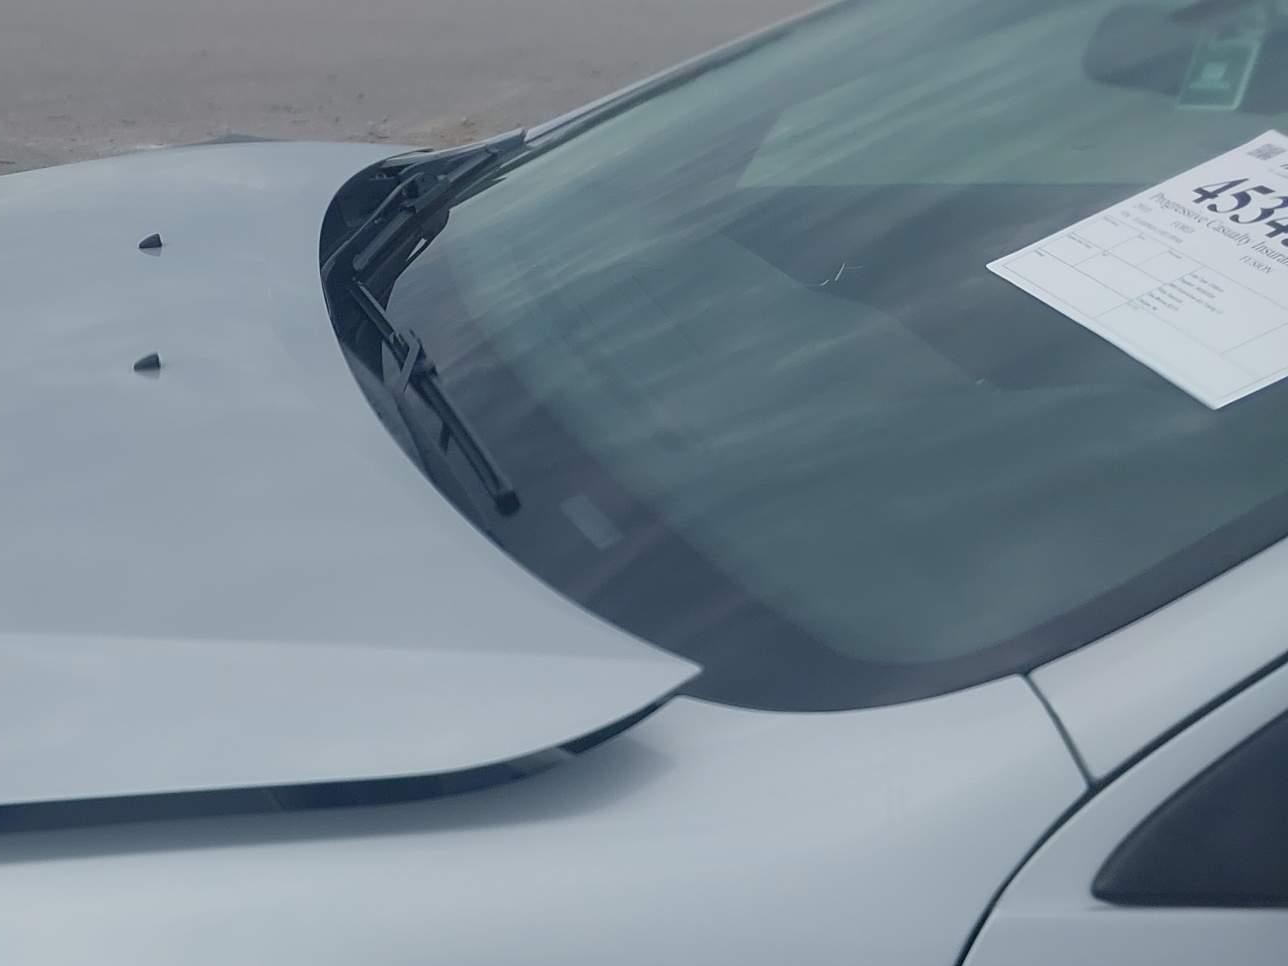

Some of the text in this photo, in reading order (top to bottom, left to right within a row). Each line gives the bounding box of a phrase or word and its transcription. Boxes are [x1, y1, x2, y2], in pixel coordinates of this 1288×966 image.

[1150, 192, 1209, 223] Progressive
[1206, 220, 1250, 246] Casualty
[1193, 178, 1288, 247] 4534
